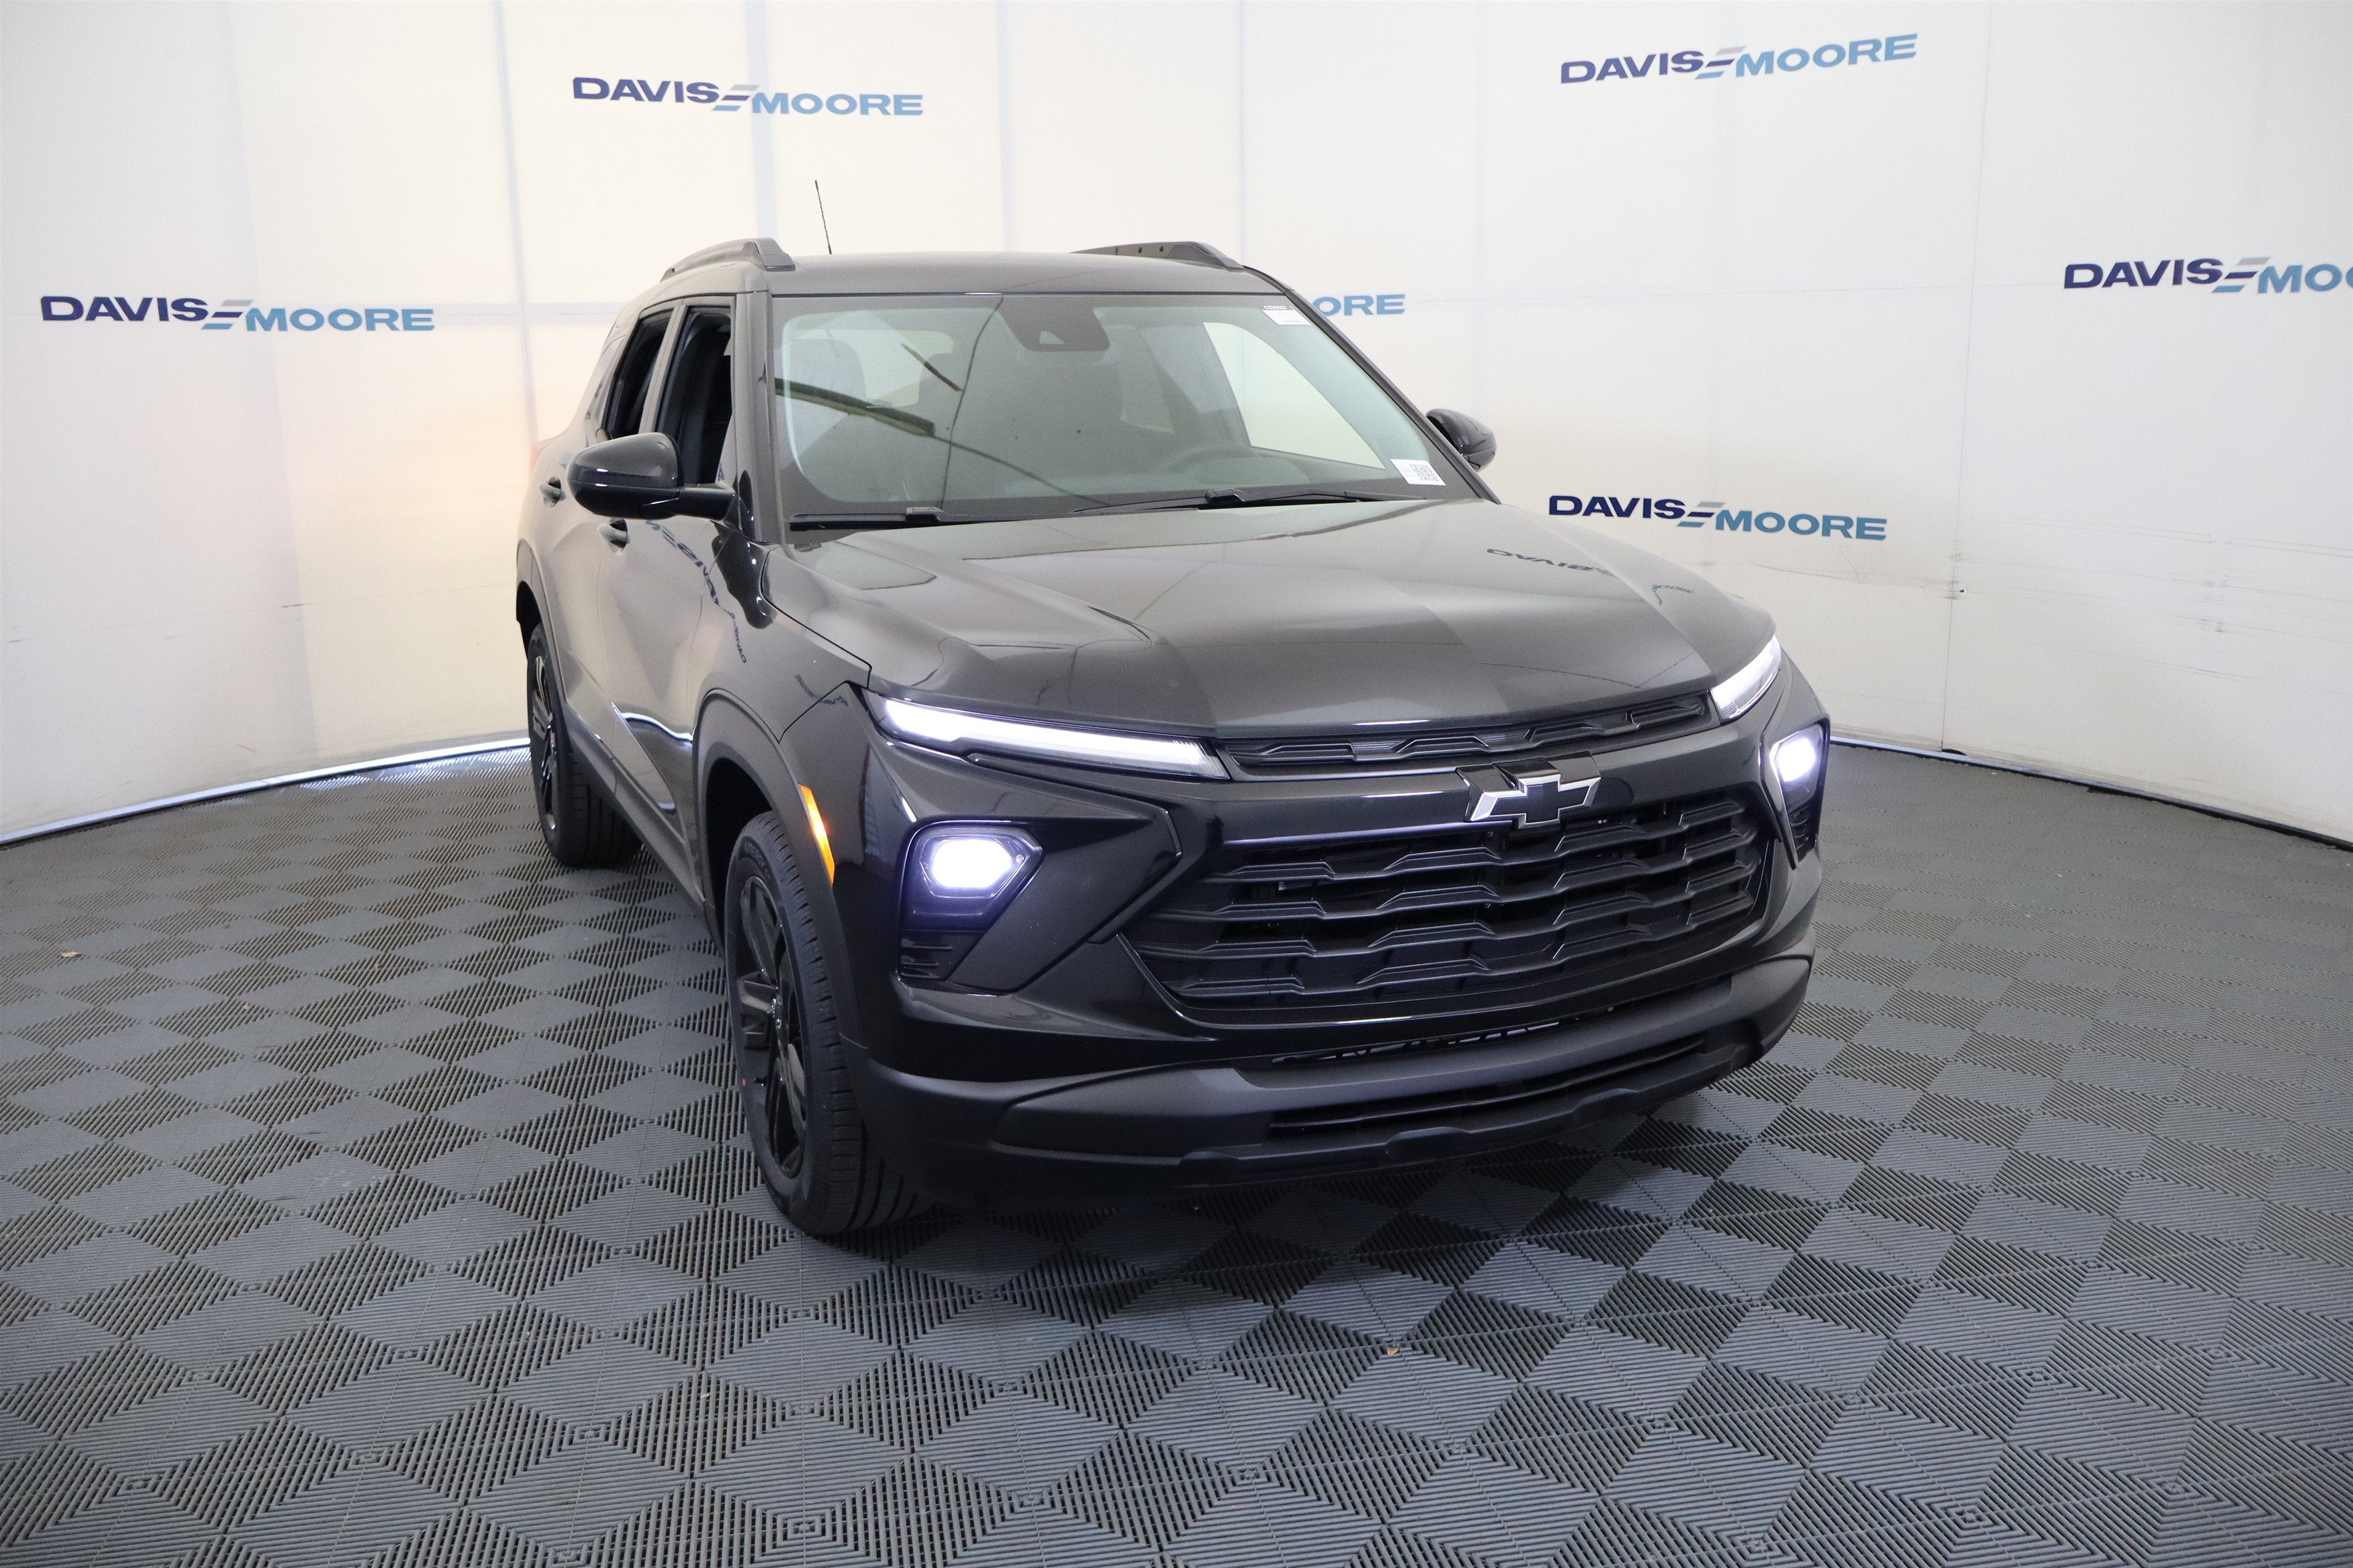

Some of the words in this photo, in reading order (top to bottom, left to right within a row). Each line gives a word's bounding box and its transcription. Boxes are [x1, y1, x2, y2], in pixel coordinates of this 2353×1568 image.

[1560, 50, 1704, 84] DAVIS
[1736, 33, 1918, 78] MOORE
[572, 76, 720, 104] DAVIS
[751, 92, 924, 116] MOORE
[2063, 257, 2224, 289] DAVIS
[2257, 263, 2353, 294] MO
[40, 295, 209, 322] DAVIS
[245, 308, 435, 332] MOORE
[1313, 294, 1405, 316] ORE
[1548, 495, 1686, 520] DAVIS
[1715, 509, 1888, 541] MOORE
